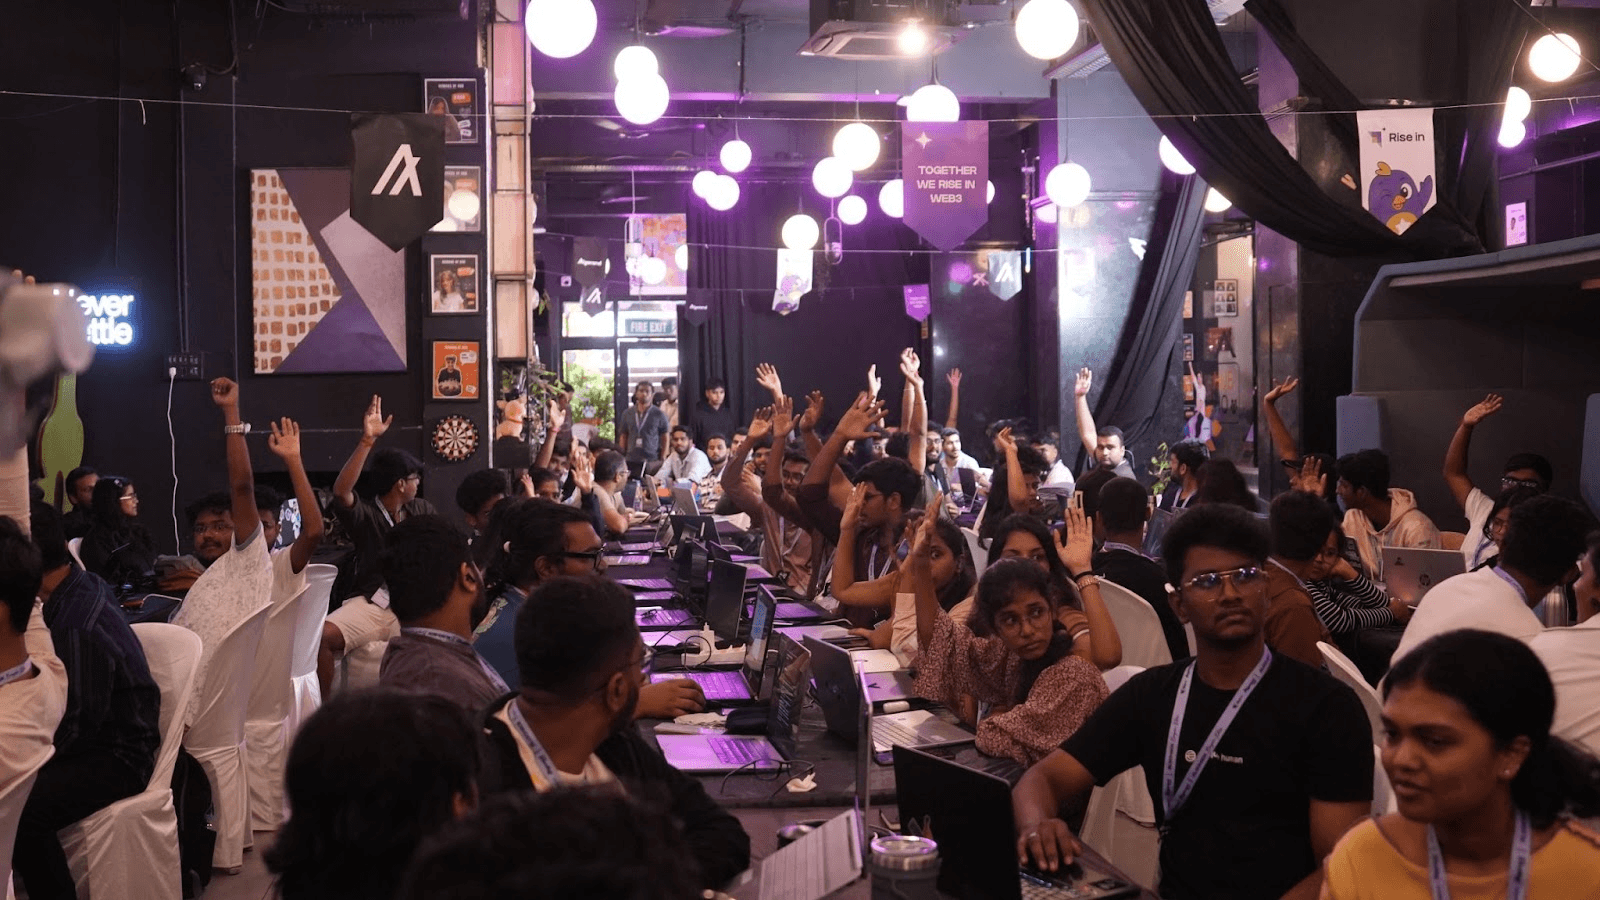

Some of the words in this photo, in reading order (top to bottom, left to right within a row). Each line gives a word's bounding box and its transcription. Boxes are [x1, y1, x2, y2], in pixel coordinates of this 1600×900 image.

[1389, 132, 1413, 142] Rise
[1415, 131, 1425, 142] in
[918, 165, 977, 175] TOGETHER
[916, 179, 936, 189] WE
[938, 179, 963, 189] RISE
[964, 179, 976, 189] IN
[930, 193, 963, 203] WEB3
[70, 289, 134, 317] ever
[631, 320, 648, 332] FIRE
[649, 320, 666, 332] EXIT
